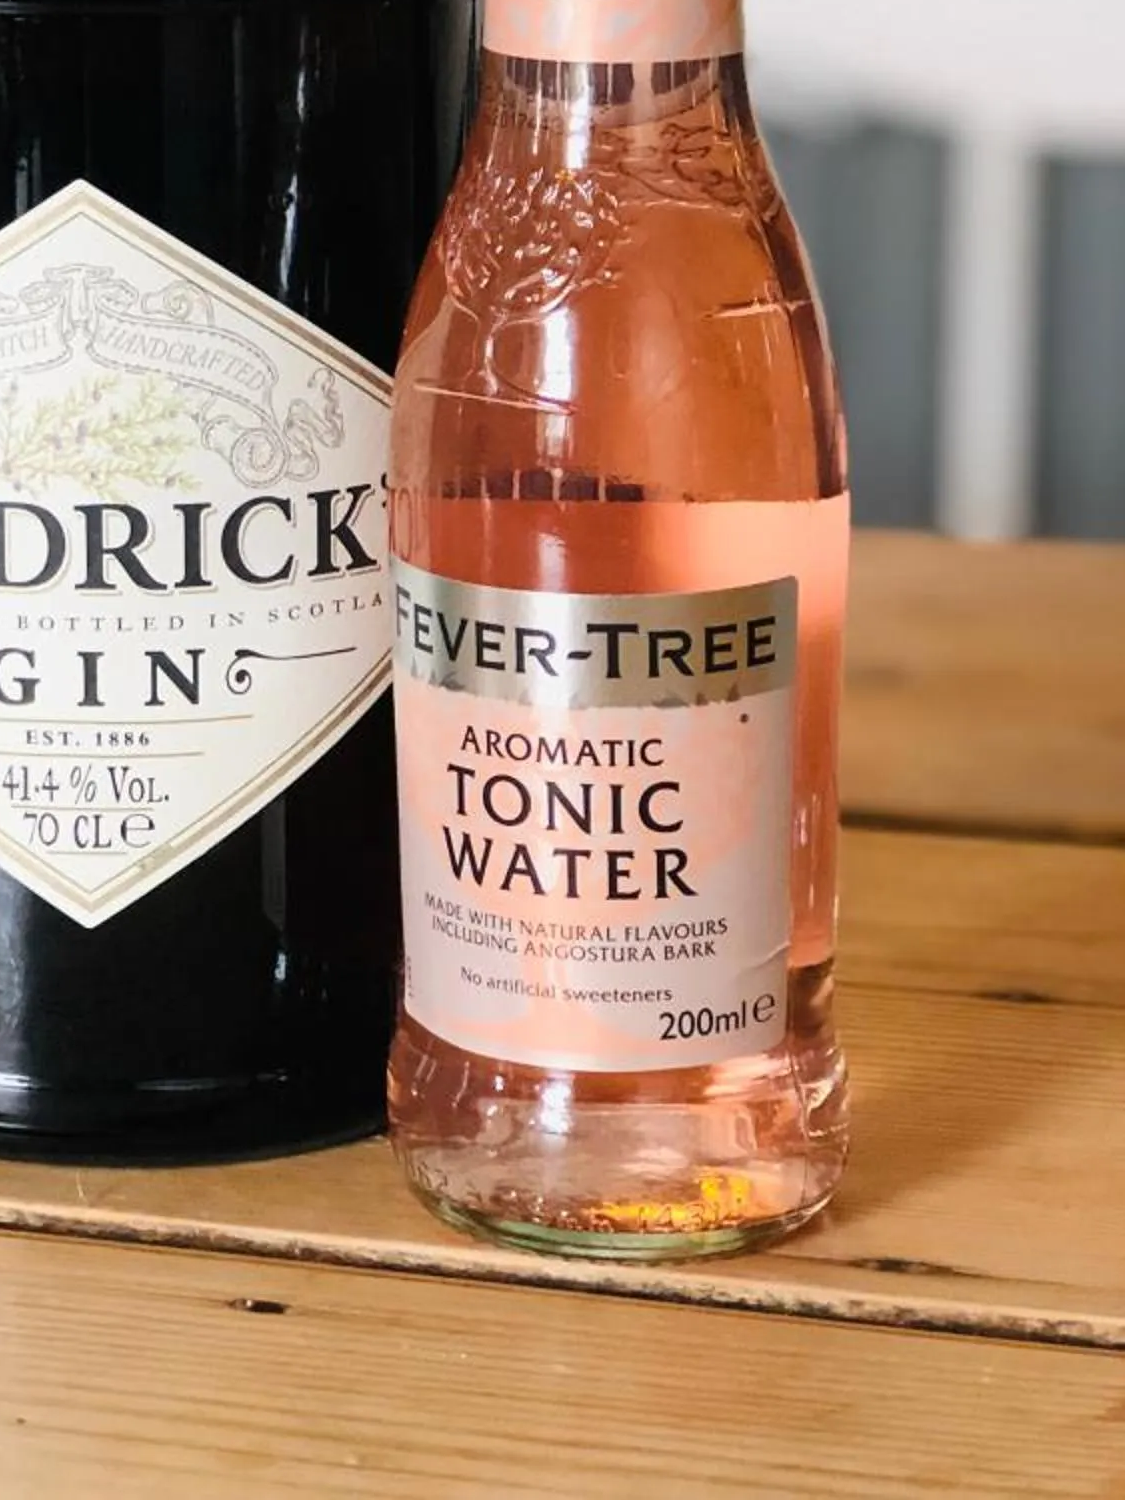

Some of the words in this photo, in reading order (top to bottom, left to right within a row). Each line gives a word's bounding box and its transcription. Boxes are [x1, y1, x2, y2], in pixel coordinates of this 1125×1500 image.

[100, 322, 267, 393] HANDCRAFTED
[17, 614, 185, 632] BOTTLED
[209, 611, 245, 629] IN
[268, 592, 383, 623] SCOTLA
[396, 584, 777, 680] FEVER-TREE
[26, 730, 81, 748] EST.
[95, 731, 151, 748] 1886
[461, 725, 665, 767] AROMATIC
[2, 765, 60, 802] 41.4
[70, 763, 96, 804] %
[447, 764, 683, 835] TONIC
[23, 813, 60, 846] 70
[442, 826, 699, 900] WATER
[425, 892, 463, 921] MADE
[468, 907, 512, 933] WITH
[519, 919, 616, 942] NATURAL
[625, 917, 728, 942] FLAVOURS
[432, 916, 518, 954] INCLUDING
[523, 940, 656, 963] ANGOSTURA
[663, 940, 717, 961] BARK
[460, 966, 482, 986] No
[486, 976, 556, 998] artificial
[562, 987, 673, 1004] sweeteners
[659, 999, 747, 1041] 200ml
